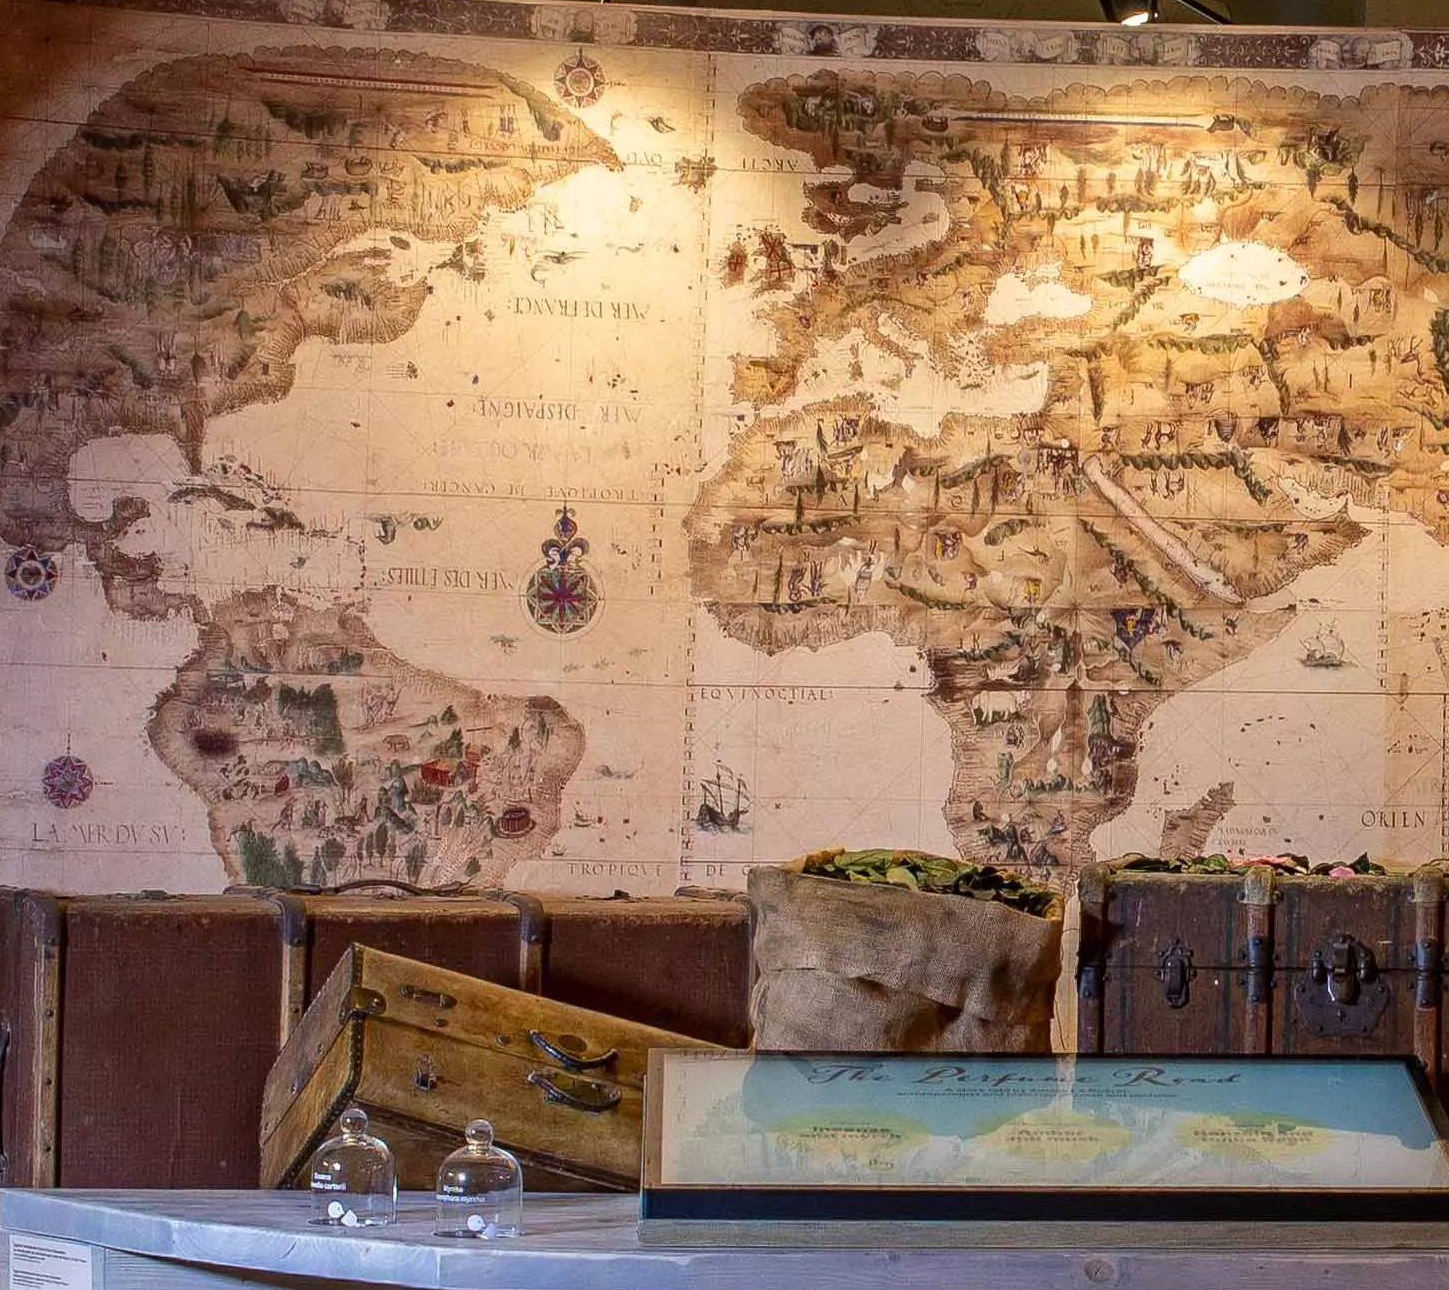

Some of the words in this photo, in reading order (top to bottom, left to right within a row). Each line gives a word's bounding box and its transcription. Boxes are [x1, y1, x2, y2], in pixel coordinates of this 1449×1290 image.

[807, 1063, 896, 1085] The
[911, 1065, 1099, 1087] Perfume
[1112, 1066, 1242, 1086] Road
